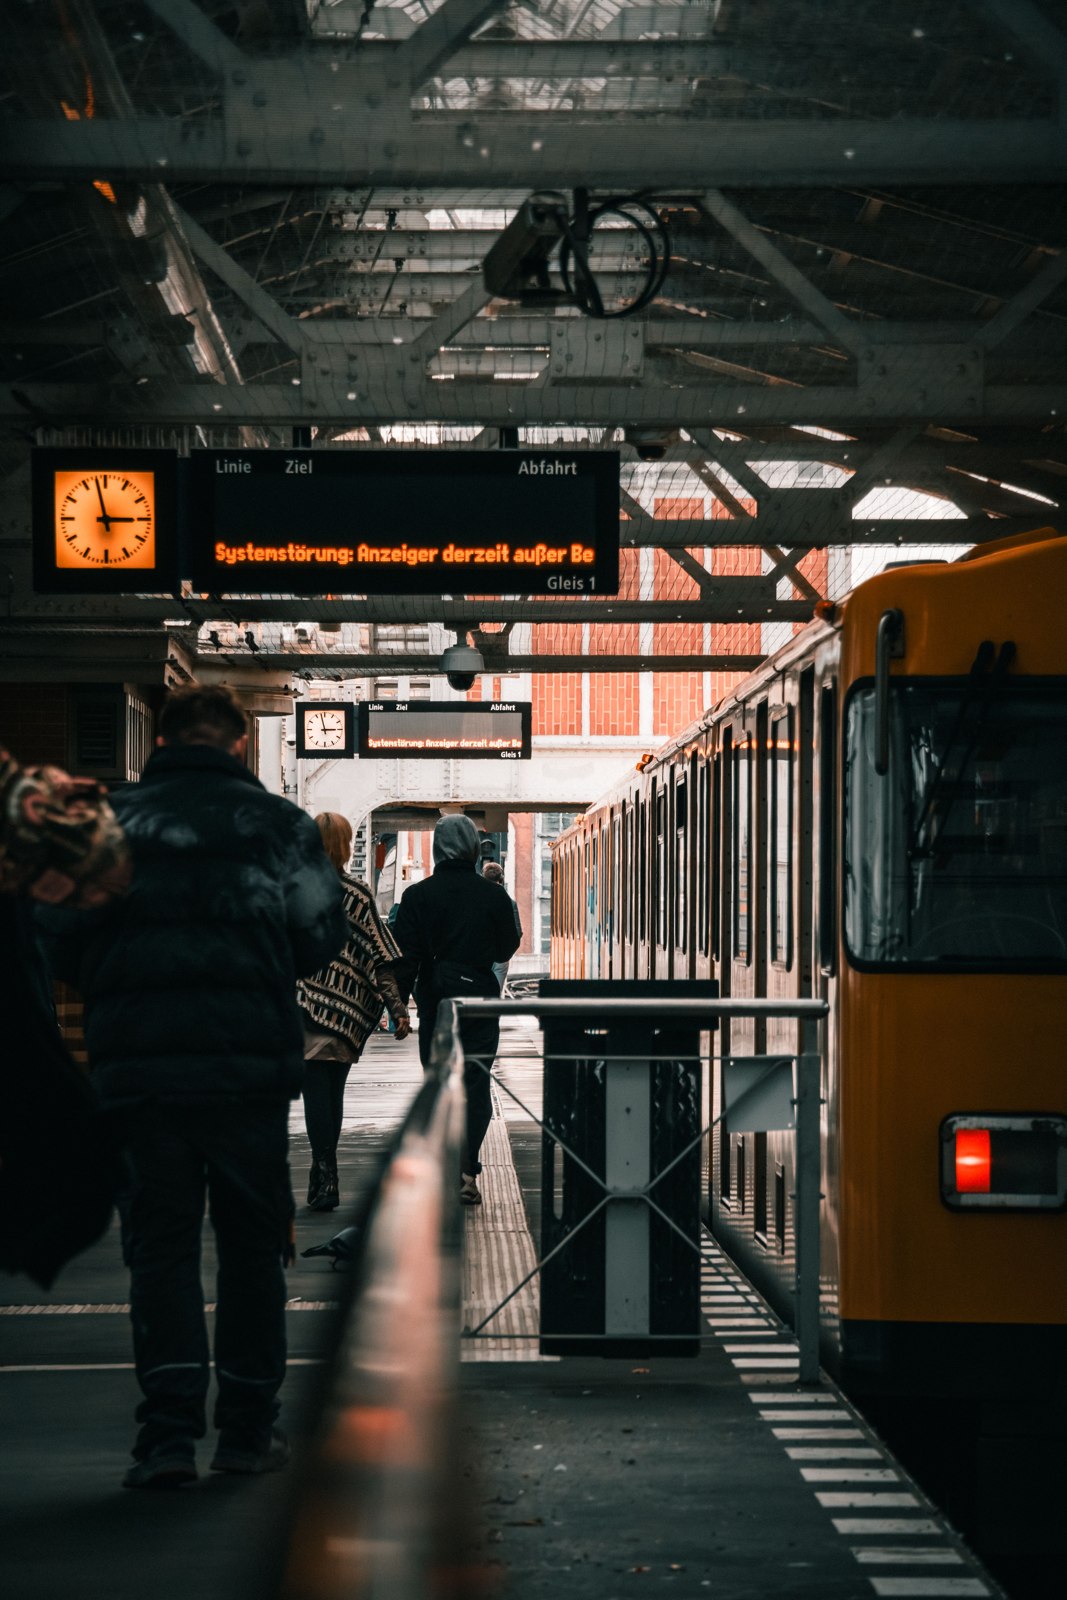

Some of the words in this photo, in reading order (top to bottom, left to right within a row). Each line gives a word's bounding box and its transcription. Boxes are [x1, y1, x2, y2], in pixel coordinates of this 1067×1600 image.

[215, 460, 252, 475] Linie
[284, 460, 313, 475] Ziel
[518, 460, 578, 475] Abfahrt
[215, 542, 354, 565] Systemstörung:
[357, 543, 439, 565] Anzeiger
[442, 543, 509, 563] derzeit
[513, 543, 567, 566] außer
[570, 544, 594, 563] Be
[547, 576, 584, 590] Gleis
[589, 576, 596, 590] 1
[425, 739, 458, 748] Anzeiger
[460, 739, 487, 748] derzeit
[511, 739, 522, 748] Be
